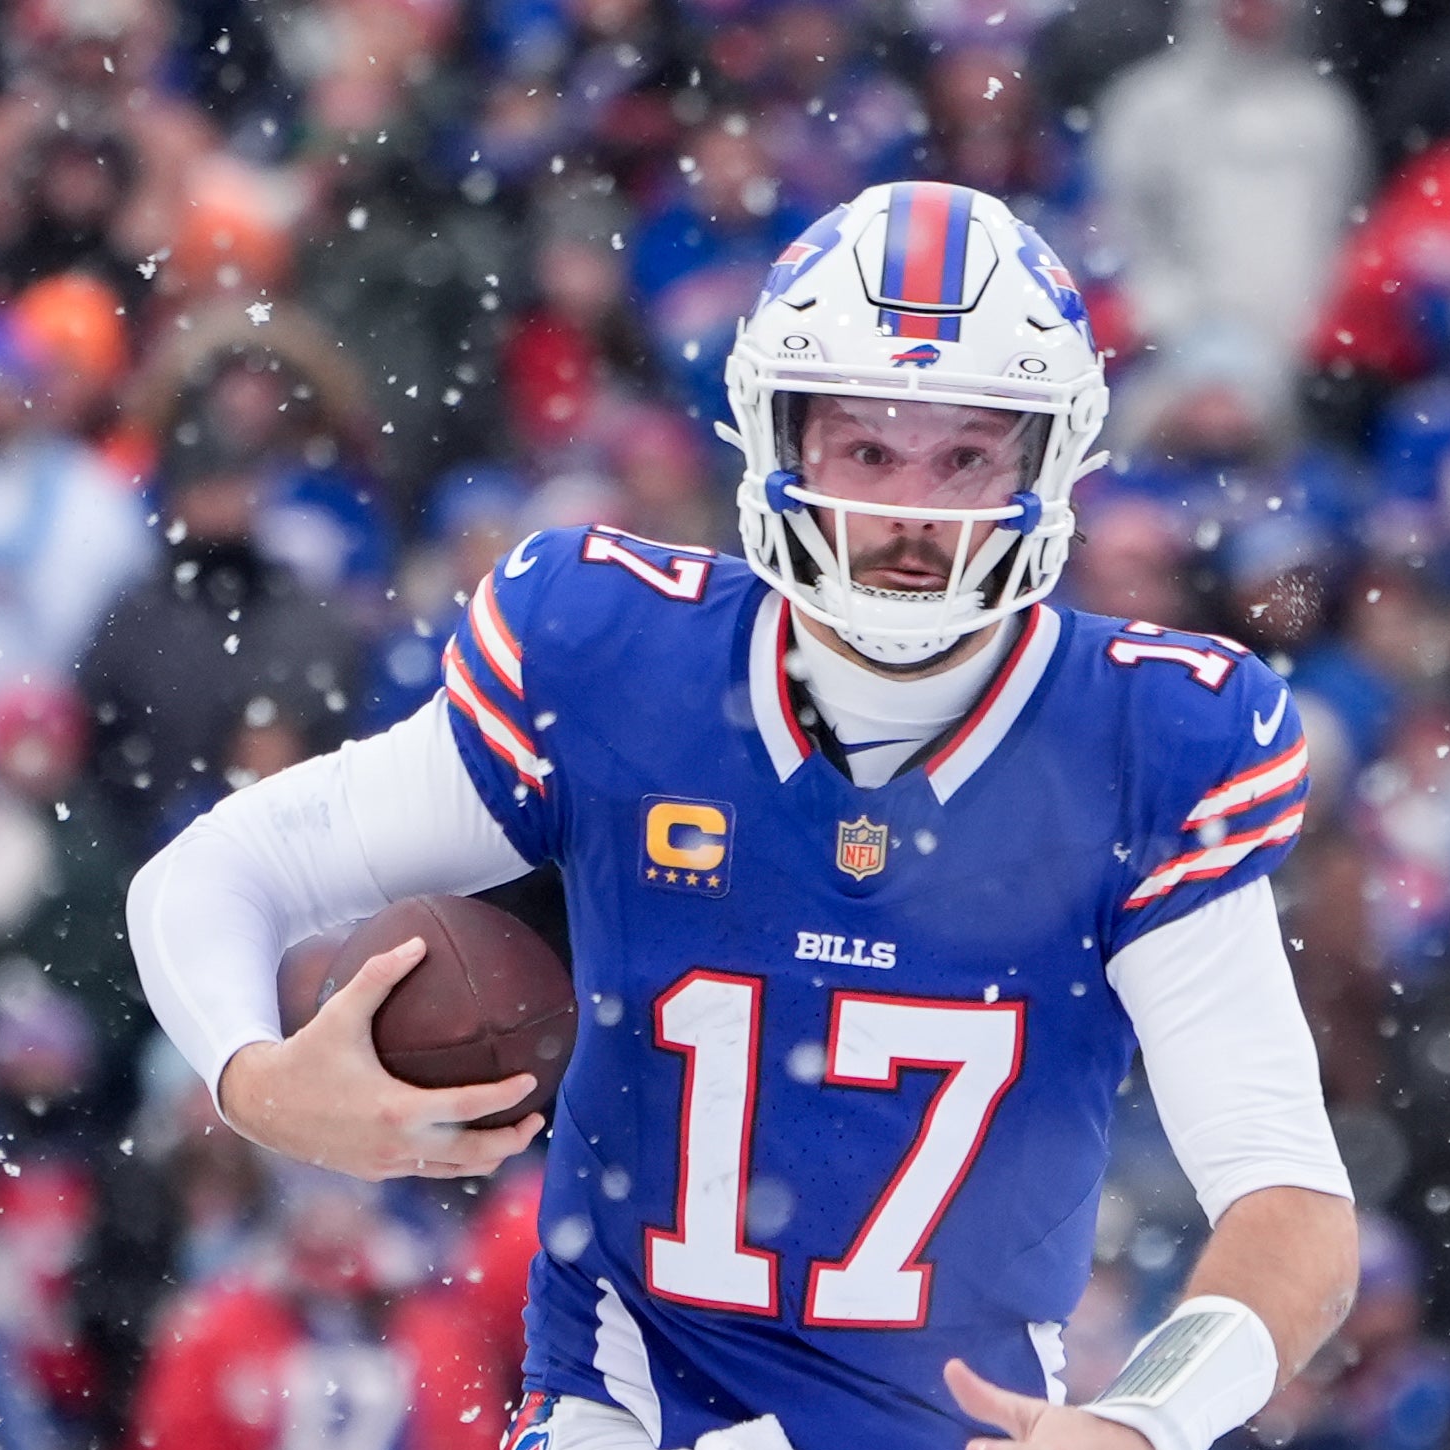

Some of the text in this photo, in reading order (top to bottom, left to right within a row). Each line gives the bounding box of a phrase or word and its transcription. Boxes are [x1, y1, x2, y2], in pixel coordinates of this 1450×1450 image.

[579, 523, 718, 605] 7
[1106, 620, 1250, 695] 1
[646, 802, 727, 871] C
[844, 845, 877, 867] NFL
[795, 931, 897, 969] BILLS
[644, 967, 1027, 1330] 17
